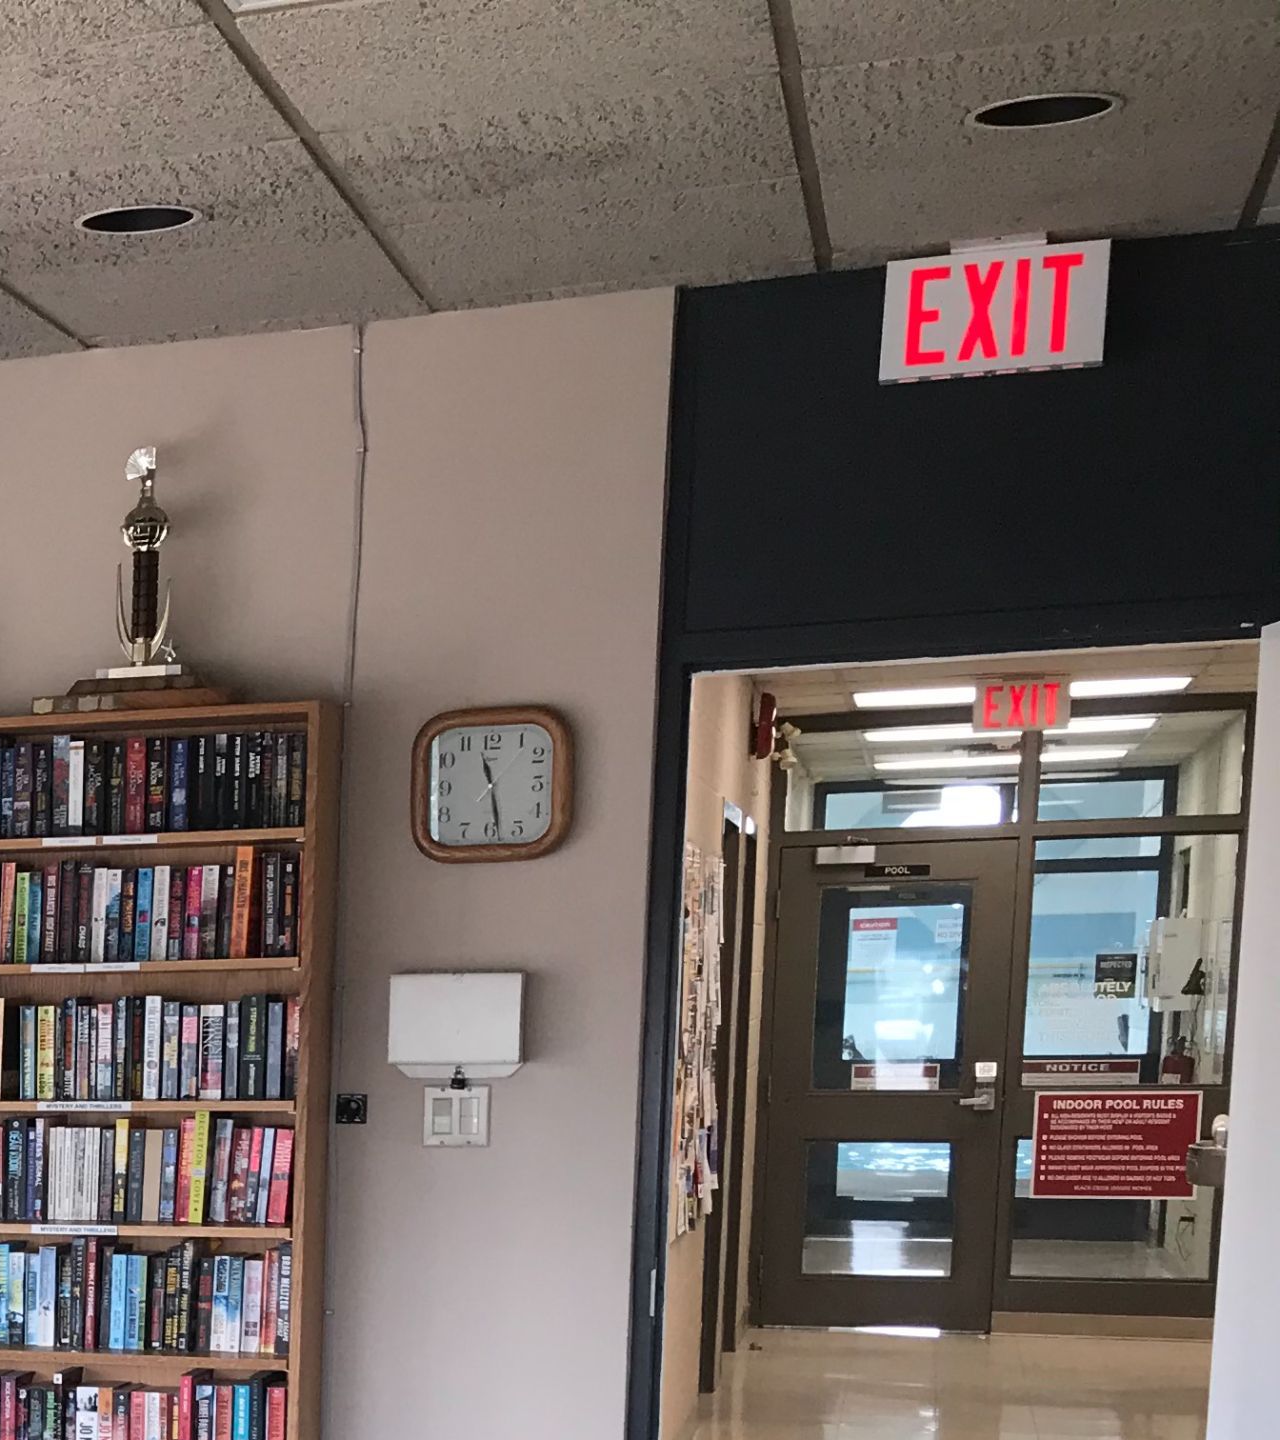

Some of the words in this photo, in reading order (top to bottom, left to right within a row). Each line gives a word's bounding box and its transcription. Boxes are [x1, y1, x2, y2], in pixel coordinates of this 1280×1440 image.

[905, 253, 1084, 366] EXIT
[983, 683, 1061, 728] EXIT
[461, 736, 471, 751] 11
[484, 734, 501, 750] 12
[520, 733, 524, 748] 1
[439, 752, 455, 768] 10
[532, 747, 544, 763] 2
[248, 752, 257, 779] JAMES
[439, 780, 452, 796] 9
[532, 776, 543, 792] 3
[438, 807, 450, 823] 8
[460, 823, 470, 838] 7
[484, 822, 497, 838] 6
[511, 821, 523, 836] 5
[885, 866, 910, 875] POOL
[203, 1018, 214, 1055] KING
[1046, 1064, 1110, 1072] NOTICE
[1053, 1099, 1102, 1110] INDOOR
[1105, 1099, 1140, 1110] POOL
[1143, 1099, 1184, 1110] RULES
[194, 1114, 207, 1166] DECEPTION
[194, 1178, 207, 1204] COVE
[280, 1256, 291, 1276] BRAD
[280, 1278, 291, 1310] MELTZER
[80, 1423, 94, 1434] JO
[100, 1423, 111, 1434] JO
